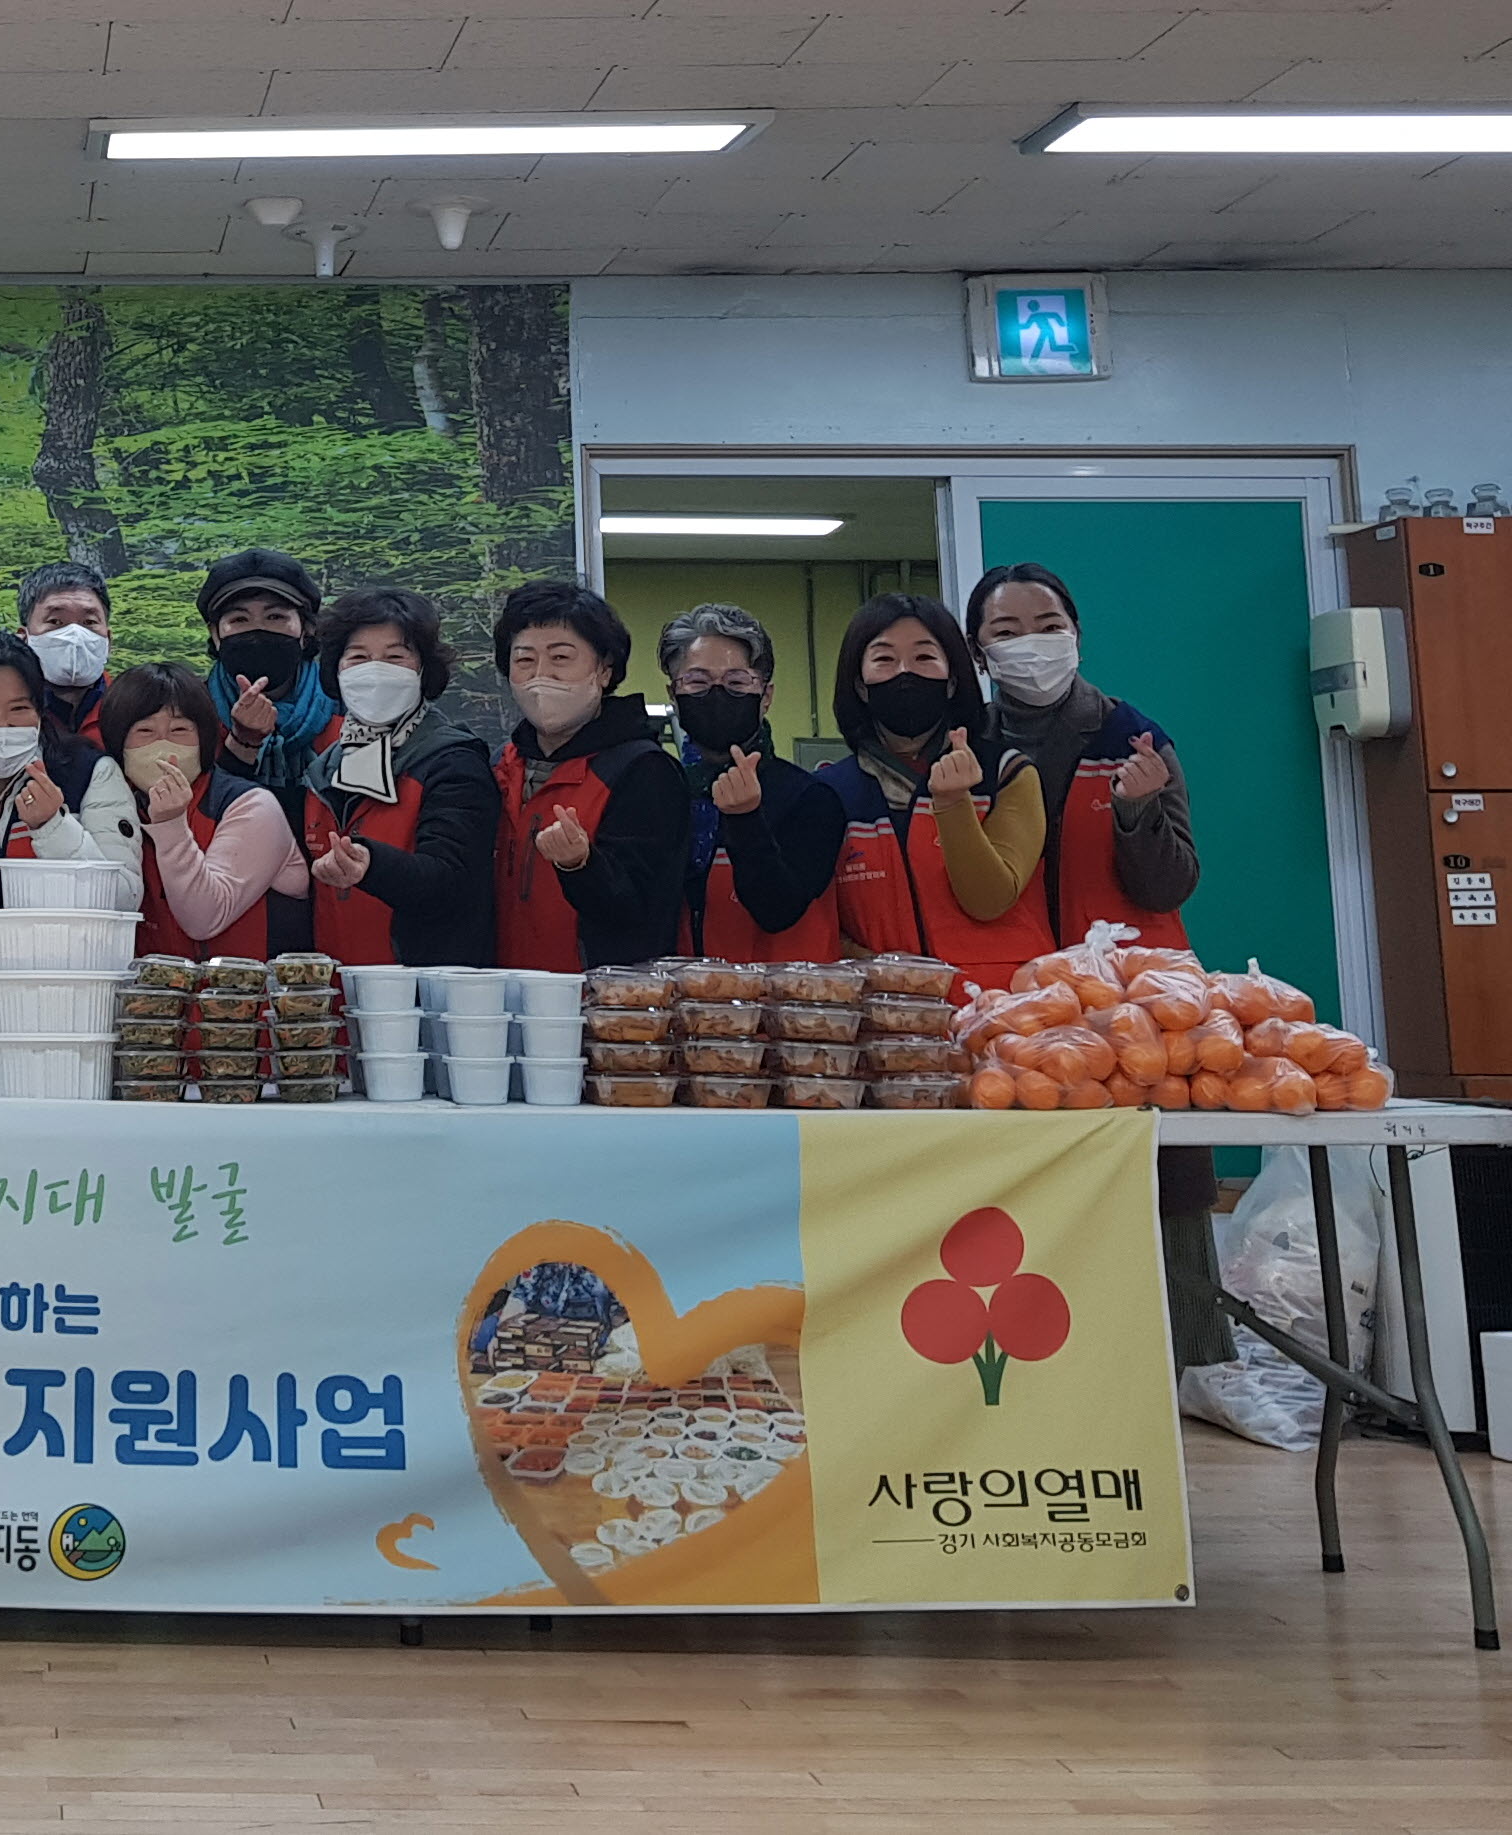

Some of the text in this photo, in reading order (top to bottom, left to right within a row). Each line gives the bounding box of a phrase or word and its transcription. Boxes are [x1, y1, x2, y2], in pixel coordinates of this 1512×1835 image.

[1448, 856, 1466, 867] 10
[151, 1163, 250, 1247] 발굴
[2, 1367, 407, 1471] 지원사업
[868, 1468, 1144, 1527] 사랑의열매
[938, 1530, 1148, 1555] 경기 사회복지공동모금회
